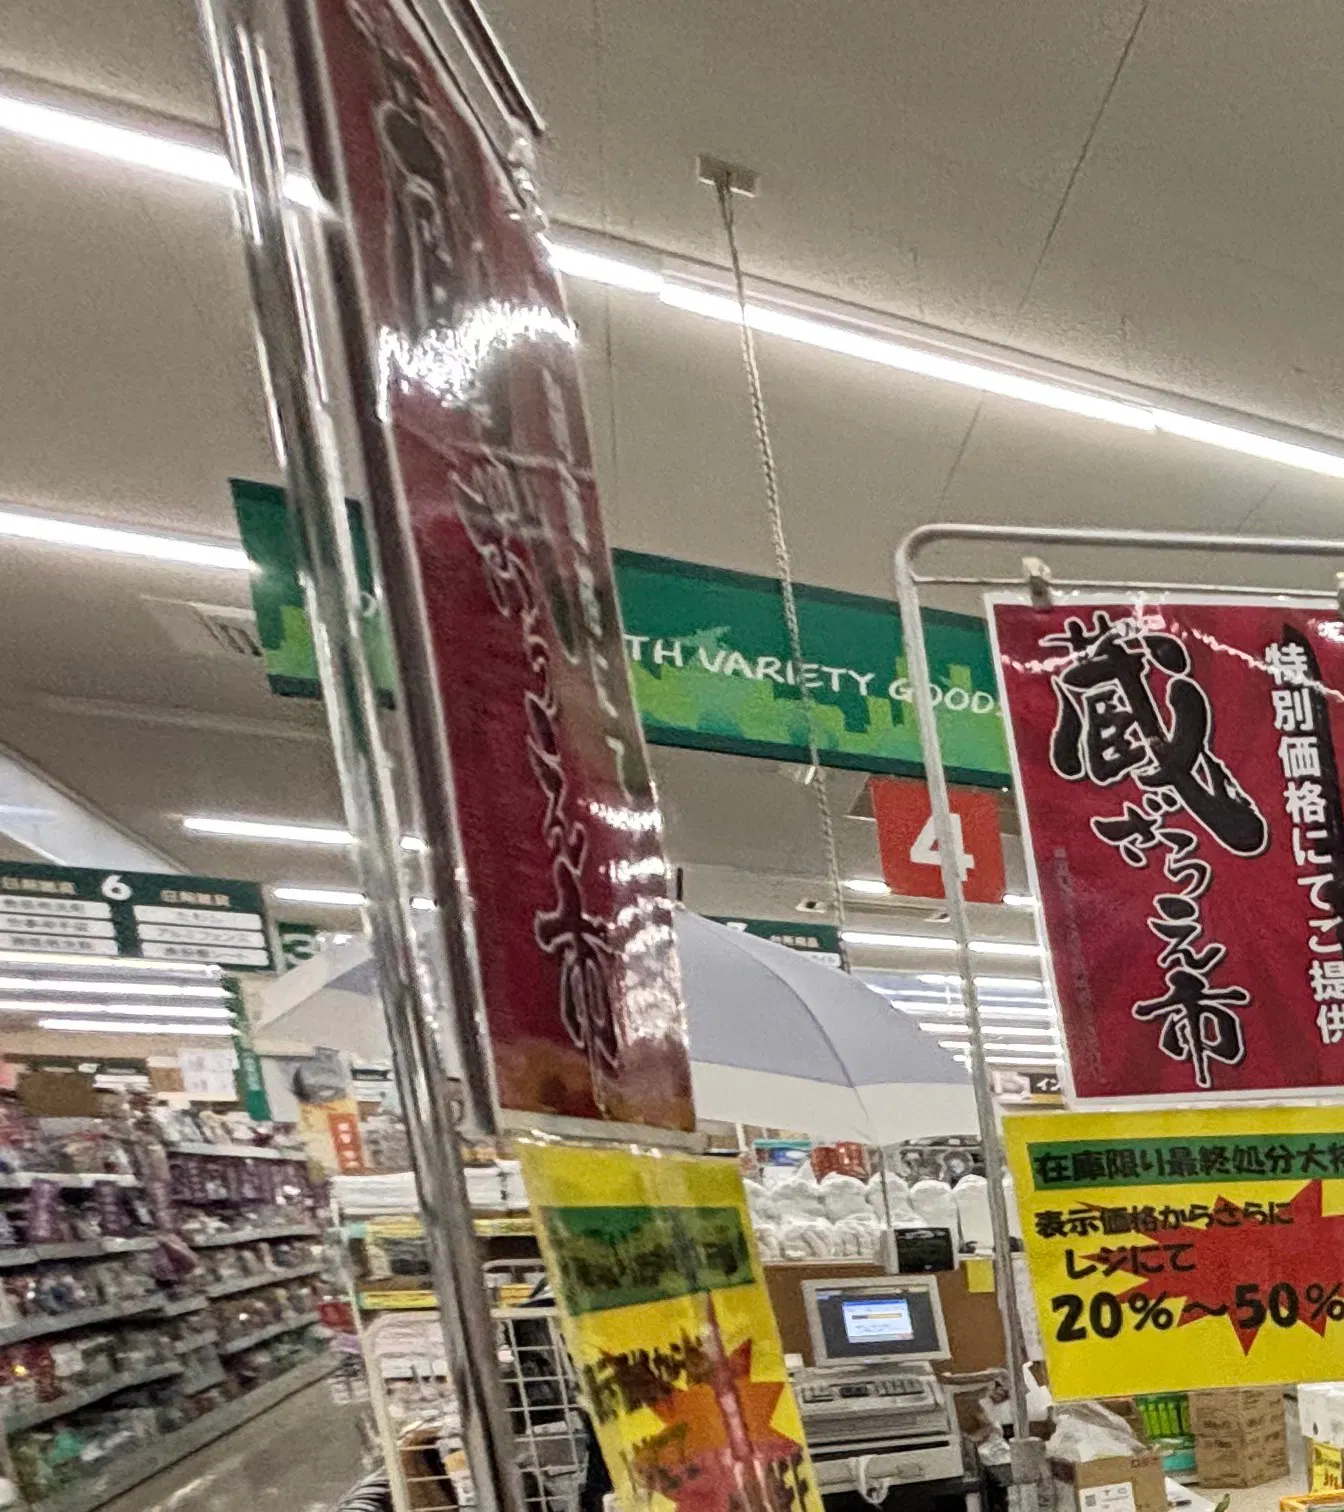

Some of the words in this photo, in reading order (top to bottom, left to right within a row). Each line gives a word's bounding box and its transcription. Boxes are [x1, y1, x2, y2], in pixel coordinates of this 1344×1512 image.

[698, 646, 874, 698] VARIETY
[909, 811, 975, 882] 4
[101, 874, 133, 901] 6
[1035, 1201, 1295, 1238] 表示価格からさらに
[1064, 1242, 1197, 1278] レジにて
